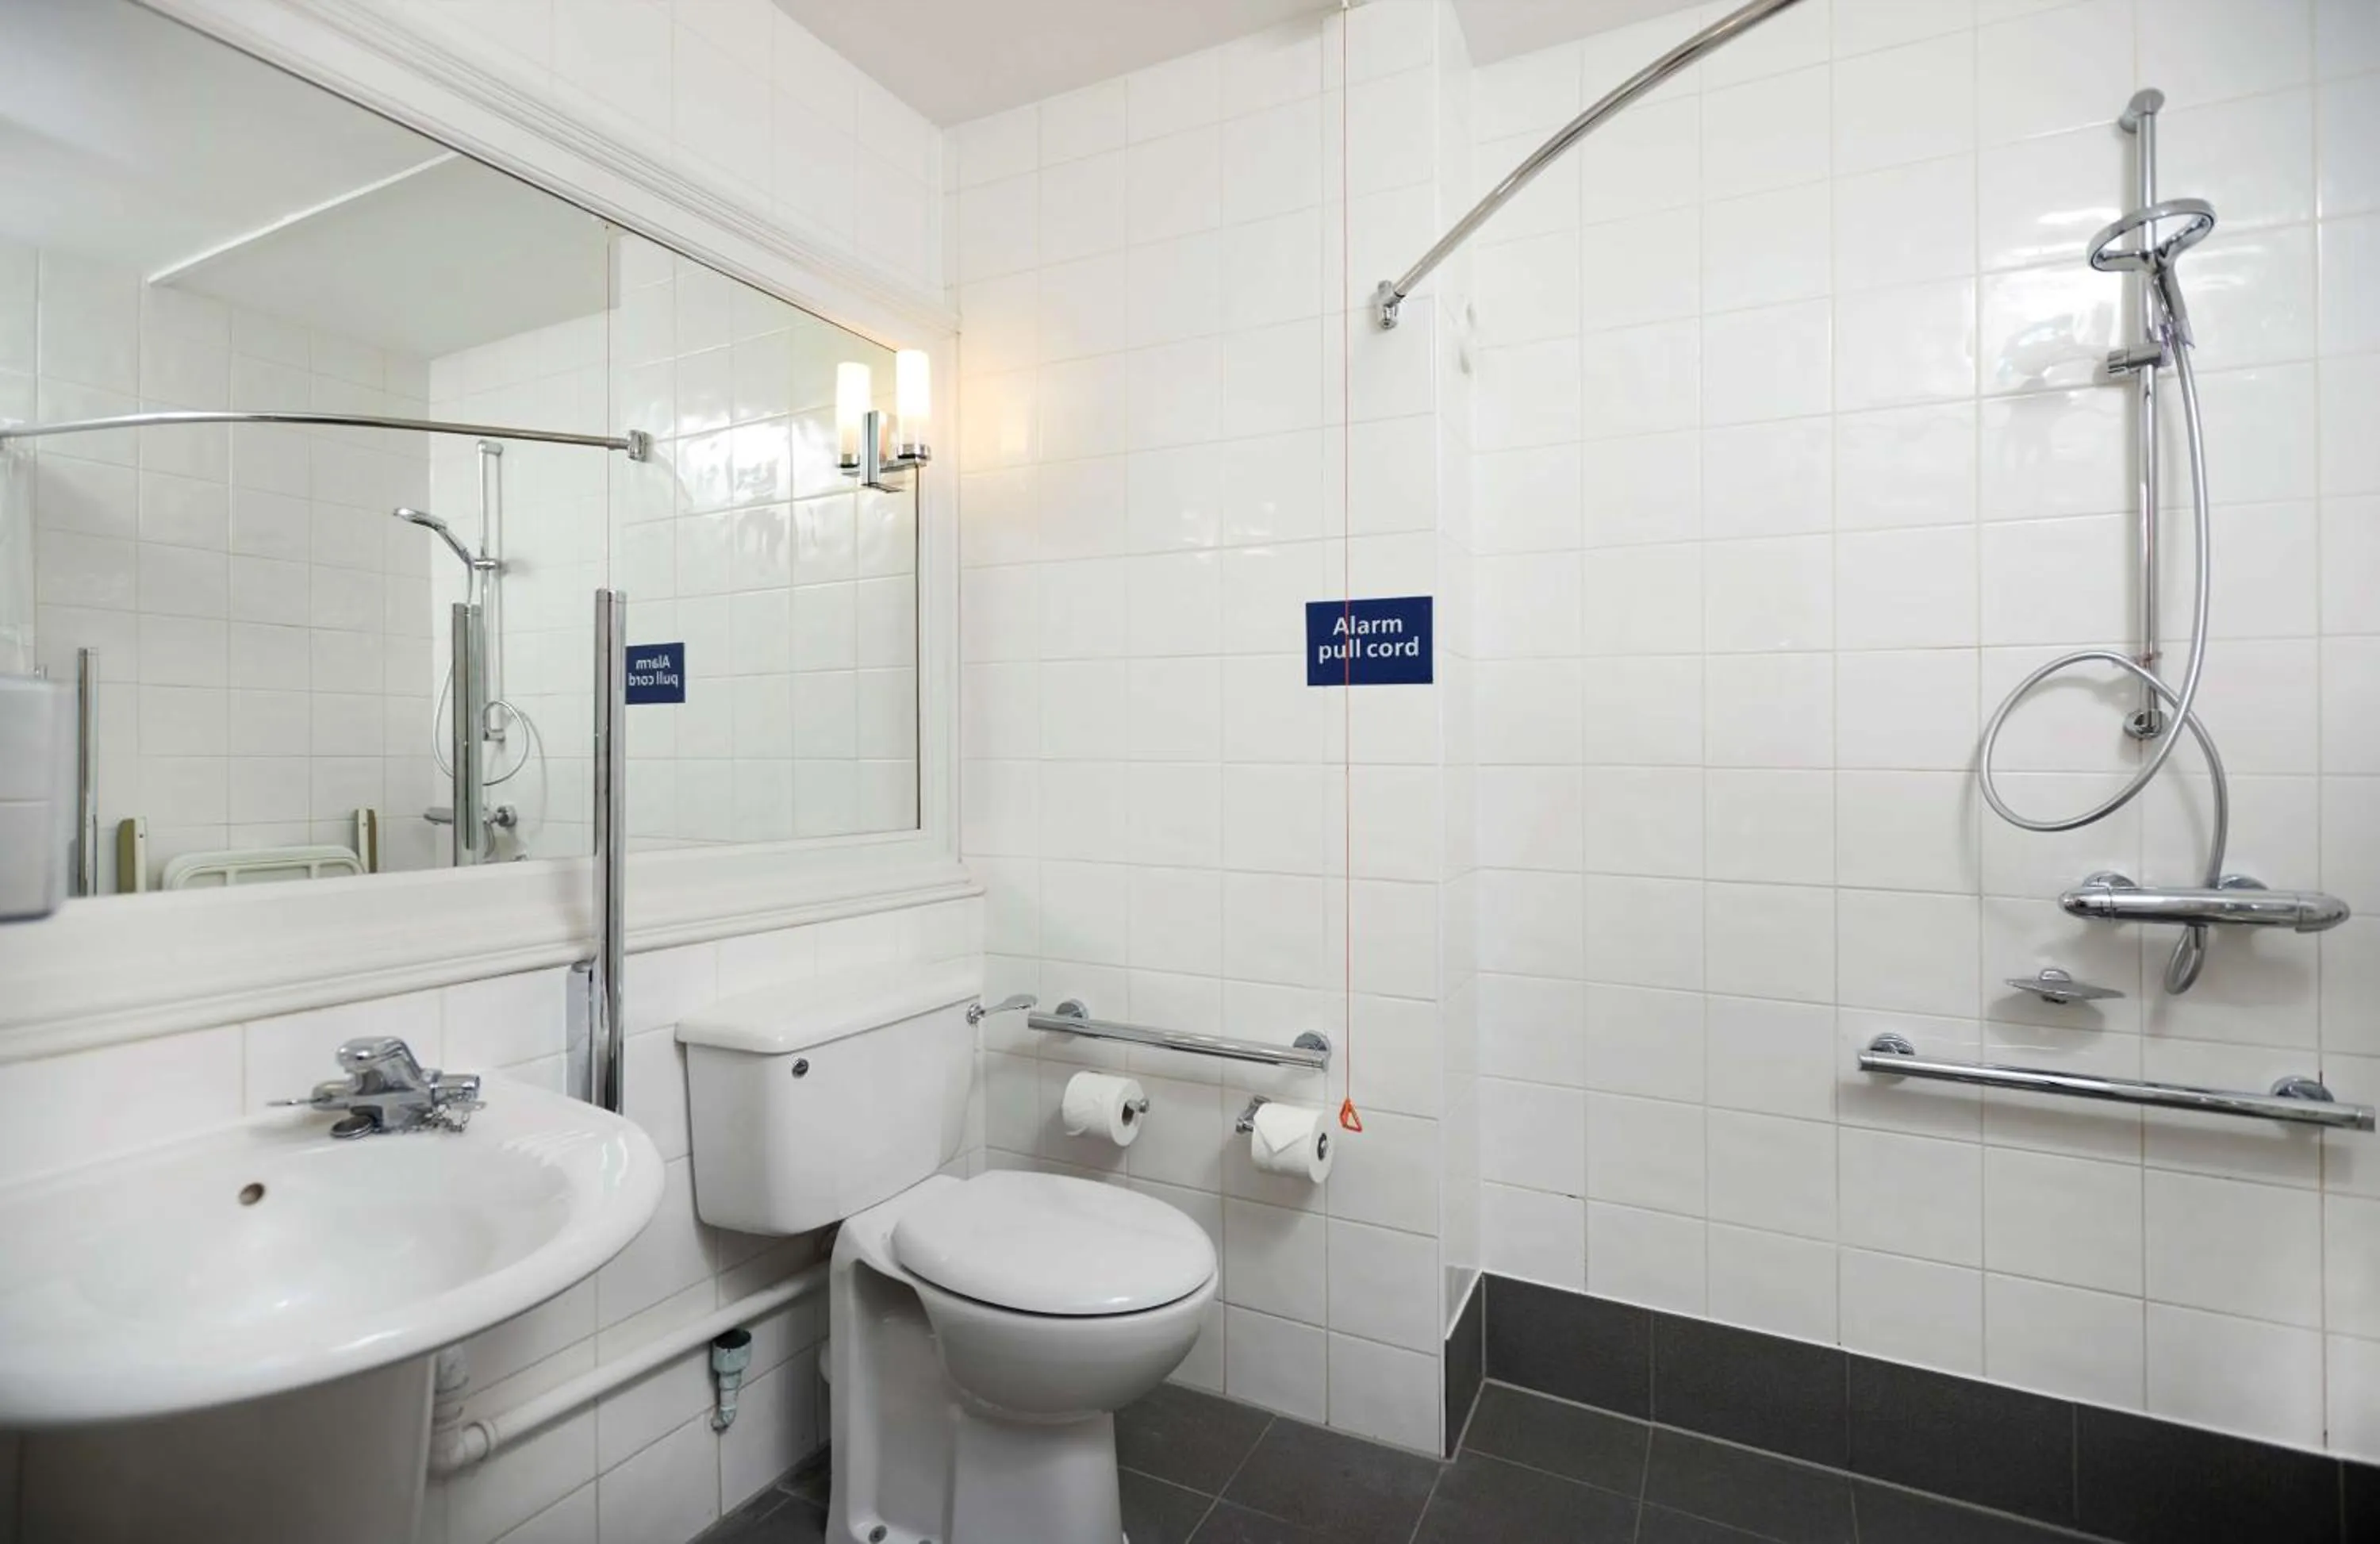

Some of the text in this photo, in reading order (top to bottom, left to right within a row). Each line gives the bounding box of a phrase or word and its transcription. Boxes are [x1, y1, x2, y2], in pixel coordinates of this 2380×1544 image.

[1333, 616, 1403, 636] Alarm
[1319, 636, 1419, 664] pull cord
